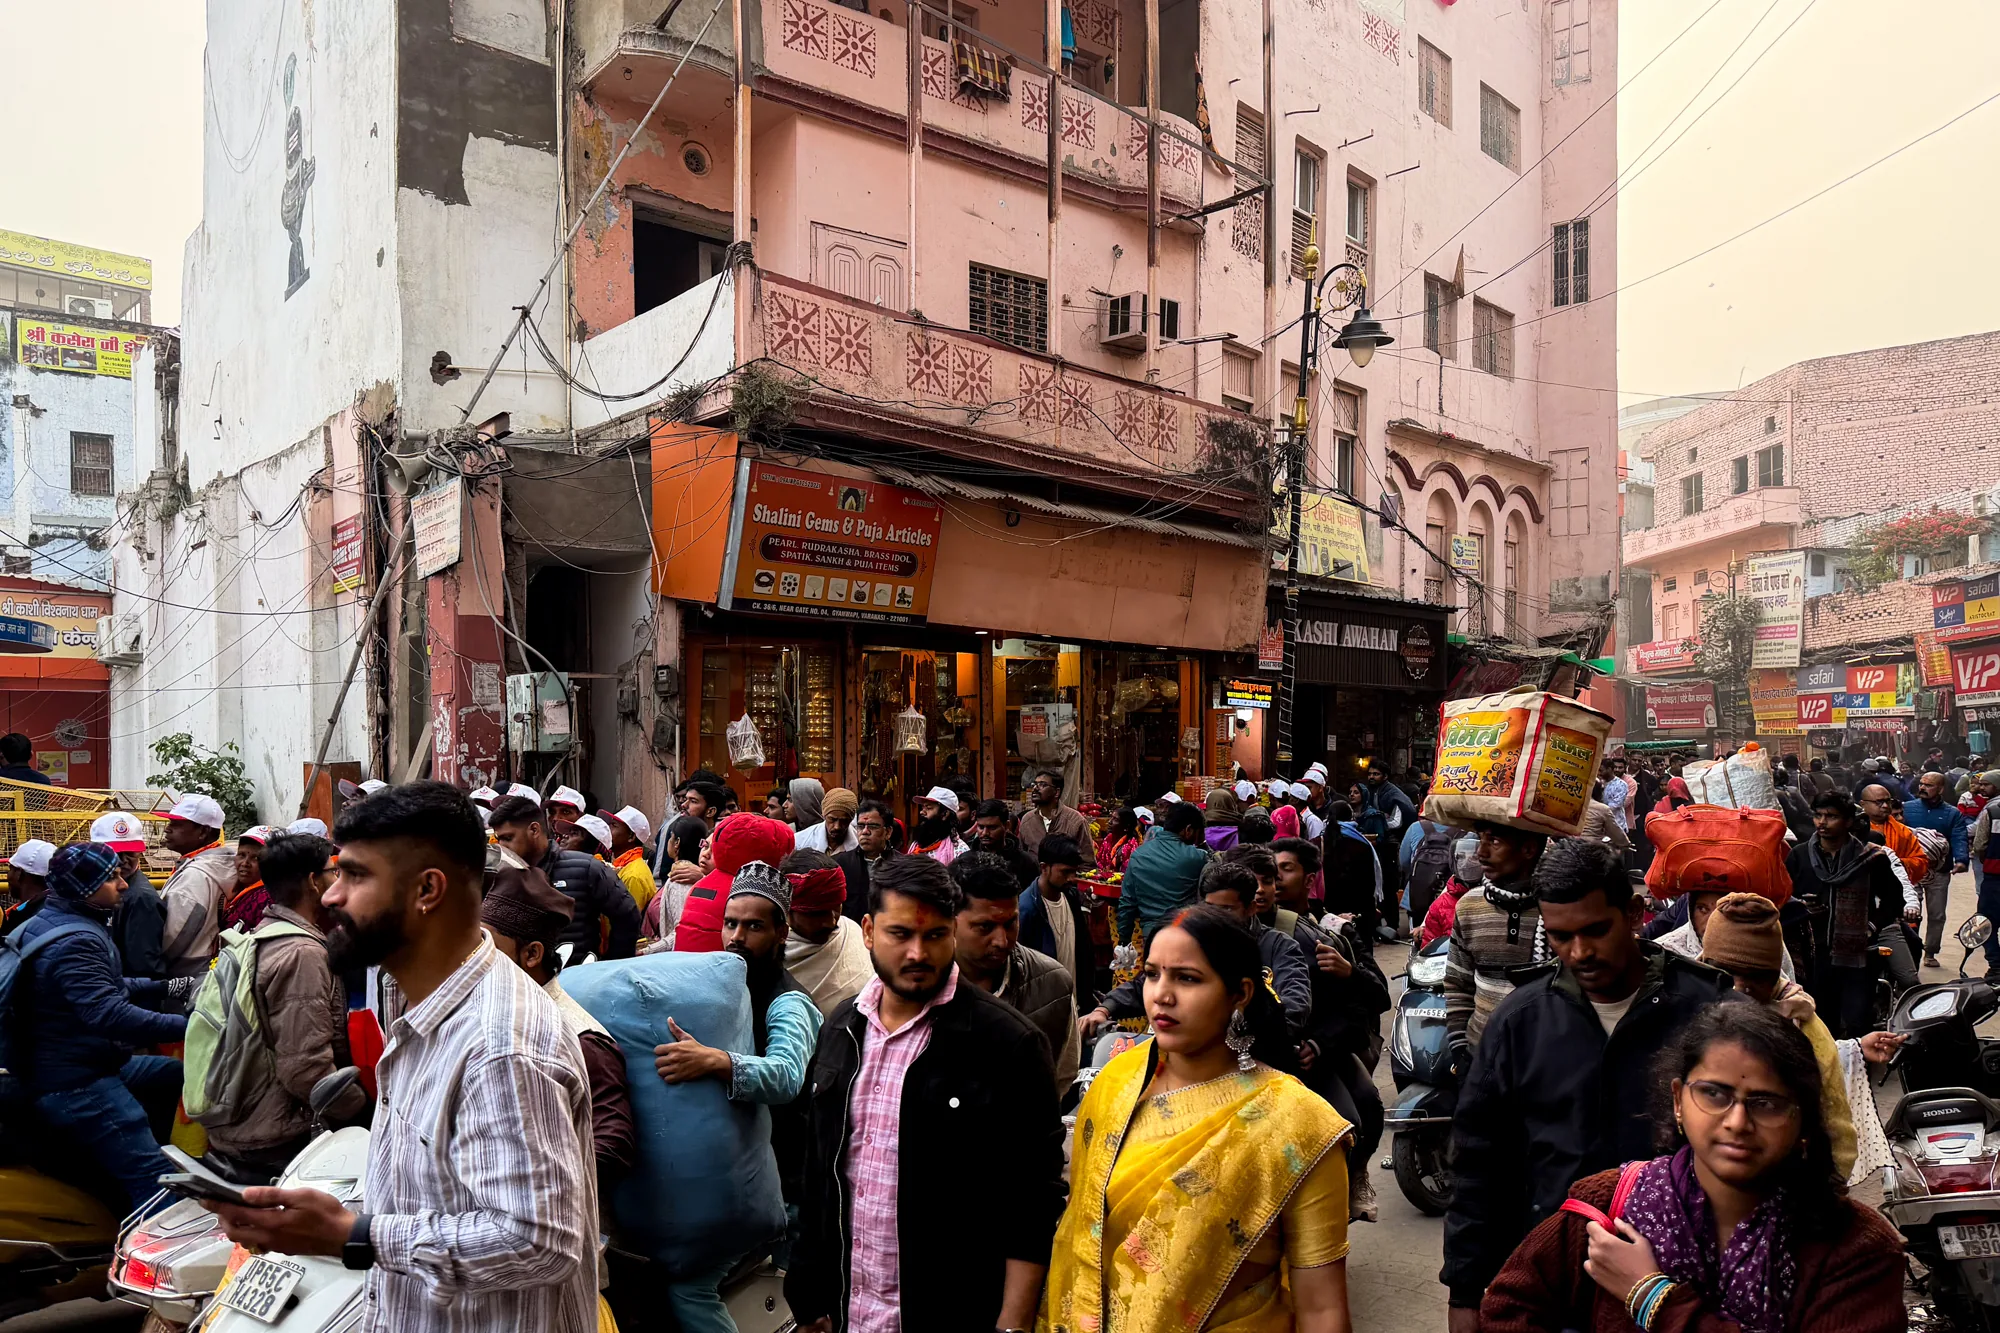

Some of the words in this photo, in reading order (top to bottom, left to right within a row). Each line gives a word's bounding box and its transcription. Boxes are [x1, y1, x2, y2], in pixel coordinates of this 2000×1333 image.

[752, 502, 802, 528] Shalini
[805, 511, 839, 533] Gems
[842, 516, 853, 536] &
[856, 518, 883, 543] Puja
[885, 524, 932, 547] Articles
[815, 554, 844, 566] SANKH
[845, 559, 852, 567] &
[854, 559, 874, 570] PUJA
[875, 562, 899, 572] ITEMS
[864, 547, 889, 560] BRASS
[1936, 587, 1959, 603] VIP
[1968, 580, 1994, 597] safari
[2, 597, 13, 615] श्री
[16, 598, 39, 616] काशी
[41, 599, 79, 618] विश्वनाथ
[81, 606, 99, 619] धाम
[779, 604, 795, 613] NEAR
[795, 606, 809, 614] GATE
[1294, 619, 1338, 646] KASHI
[1339, 624, 1398, 652] AWAHAN
[1808, 668, 1834, 685] safari
[1856, 670, 1885, 689] VIP
[1957, 653, 2000, 690] VIP
[1801, 699, 1828, 719] VIP
[1442, 770, 1479, 792] केसरी
[1922, 1107, 1962, 1118] HONDA
[1955, 1223, 2000, 1241] UP62
[245, 1258, 292, 1293] UP65C
